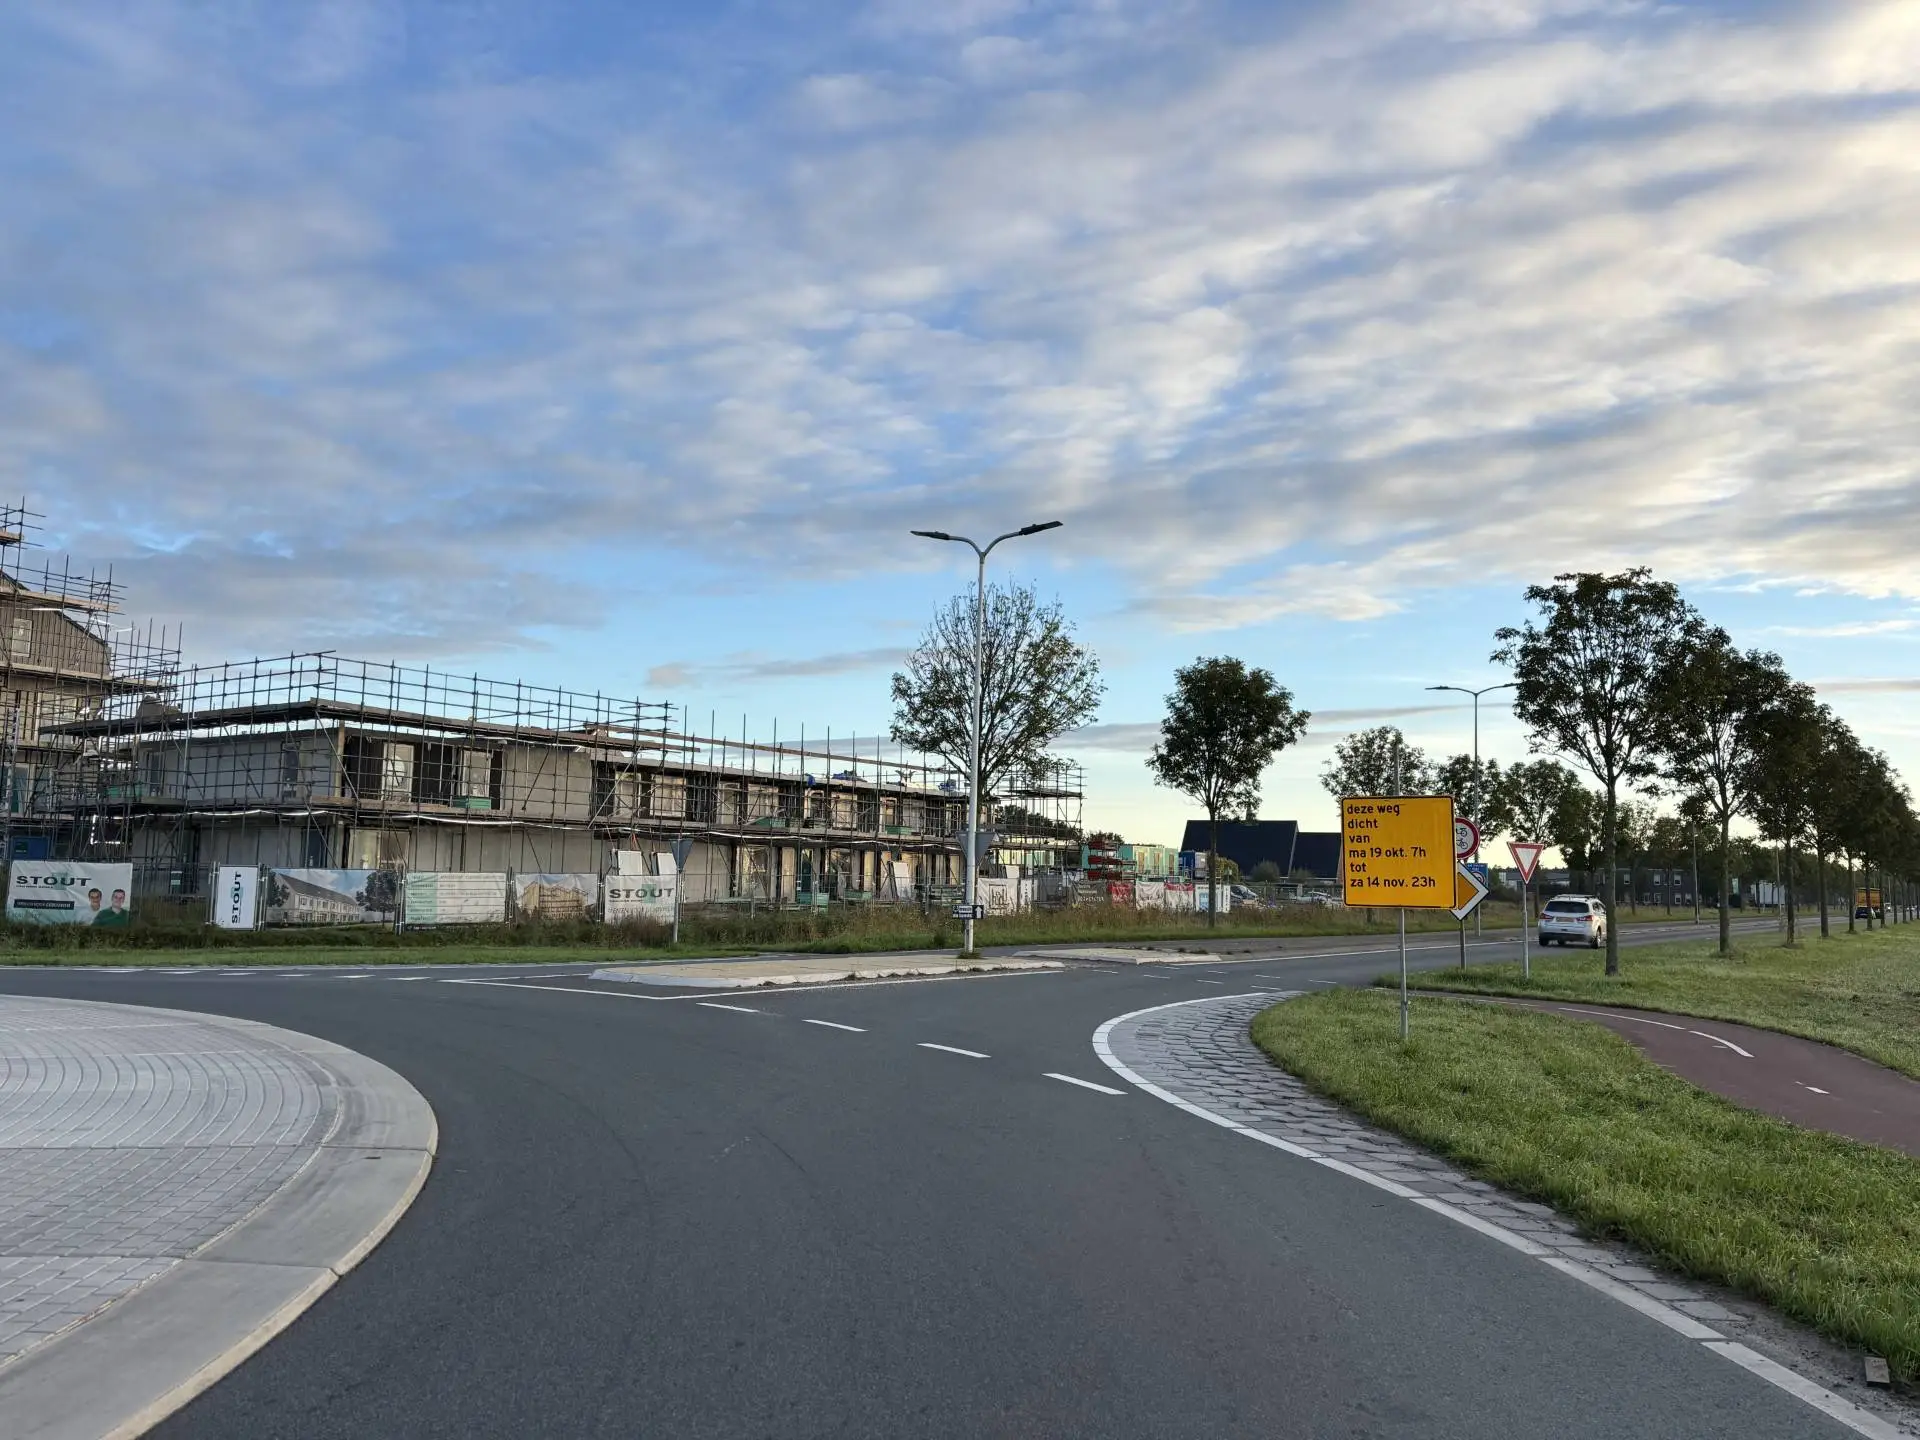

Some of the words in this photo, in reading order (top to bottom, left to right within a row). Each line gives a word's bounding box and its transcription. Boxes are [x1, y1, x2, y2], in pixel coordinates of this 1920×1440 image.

[1347, 804, 1373, 814] deze
[1377, 805, 1400, 816] weg
[1348, 819, 1378, 828] dicht
[1349, 835, 1370, 843] van
[1349, 849, 1366, 857] ma
[1370, 848, 1381, 857] 19
[1385, 848, 1407, 857] okt.
[1411, 847, 1426, 857] 7h
[1350, 863, 1367, 872] tot
[16, 876, 92, 887] STOUT
[1350, 879, 1363, 887] za
[1367, 877, 1379, 886] 14
[1384, 879, 1408, 887] nov.
[1412, 877, 1435, 887] 23h
[231, 871, 242, 924] STOUT
[609, 888, 675, 899] STOUT
